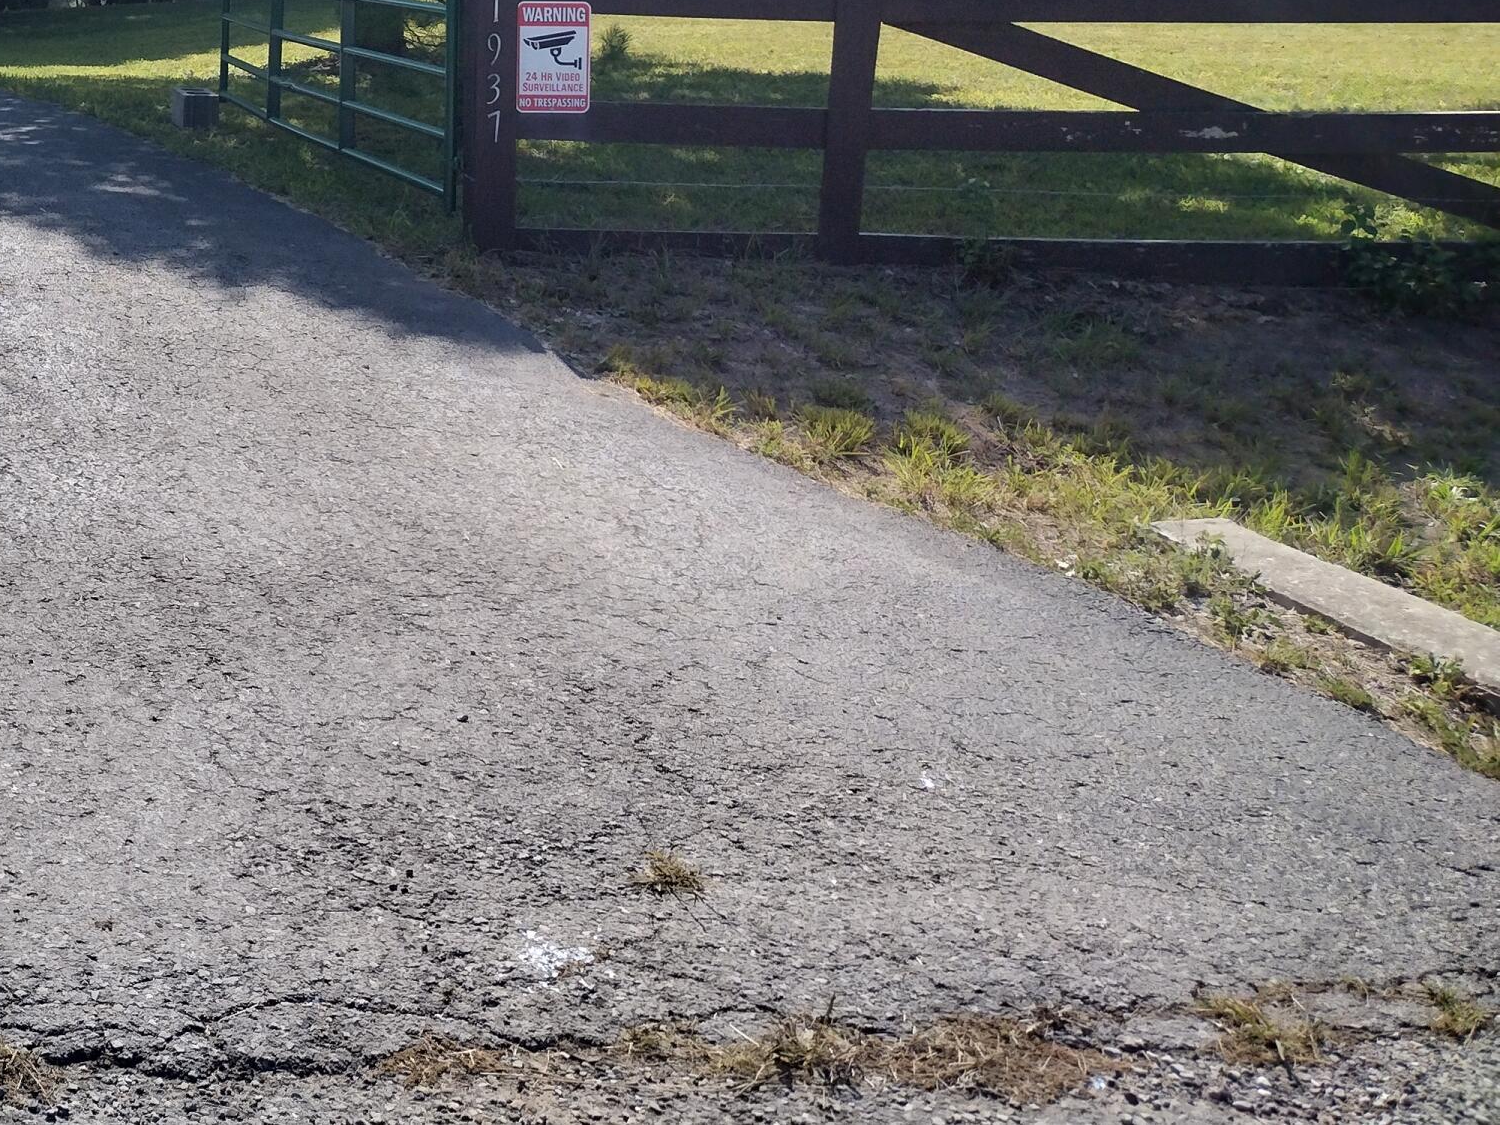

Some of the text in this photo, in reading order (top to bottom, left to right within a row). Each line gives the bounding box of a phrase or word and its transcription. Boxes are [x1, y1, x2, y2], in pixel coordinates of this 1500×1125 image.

[522, 6, 586, 22] WARNING
[526, 72, 537, 81] 24
[541, 72, 553, 81] HR
[519, 98, 586, 107] NO TRESPASSING
